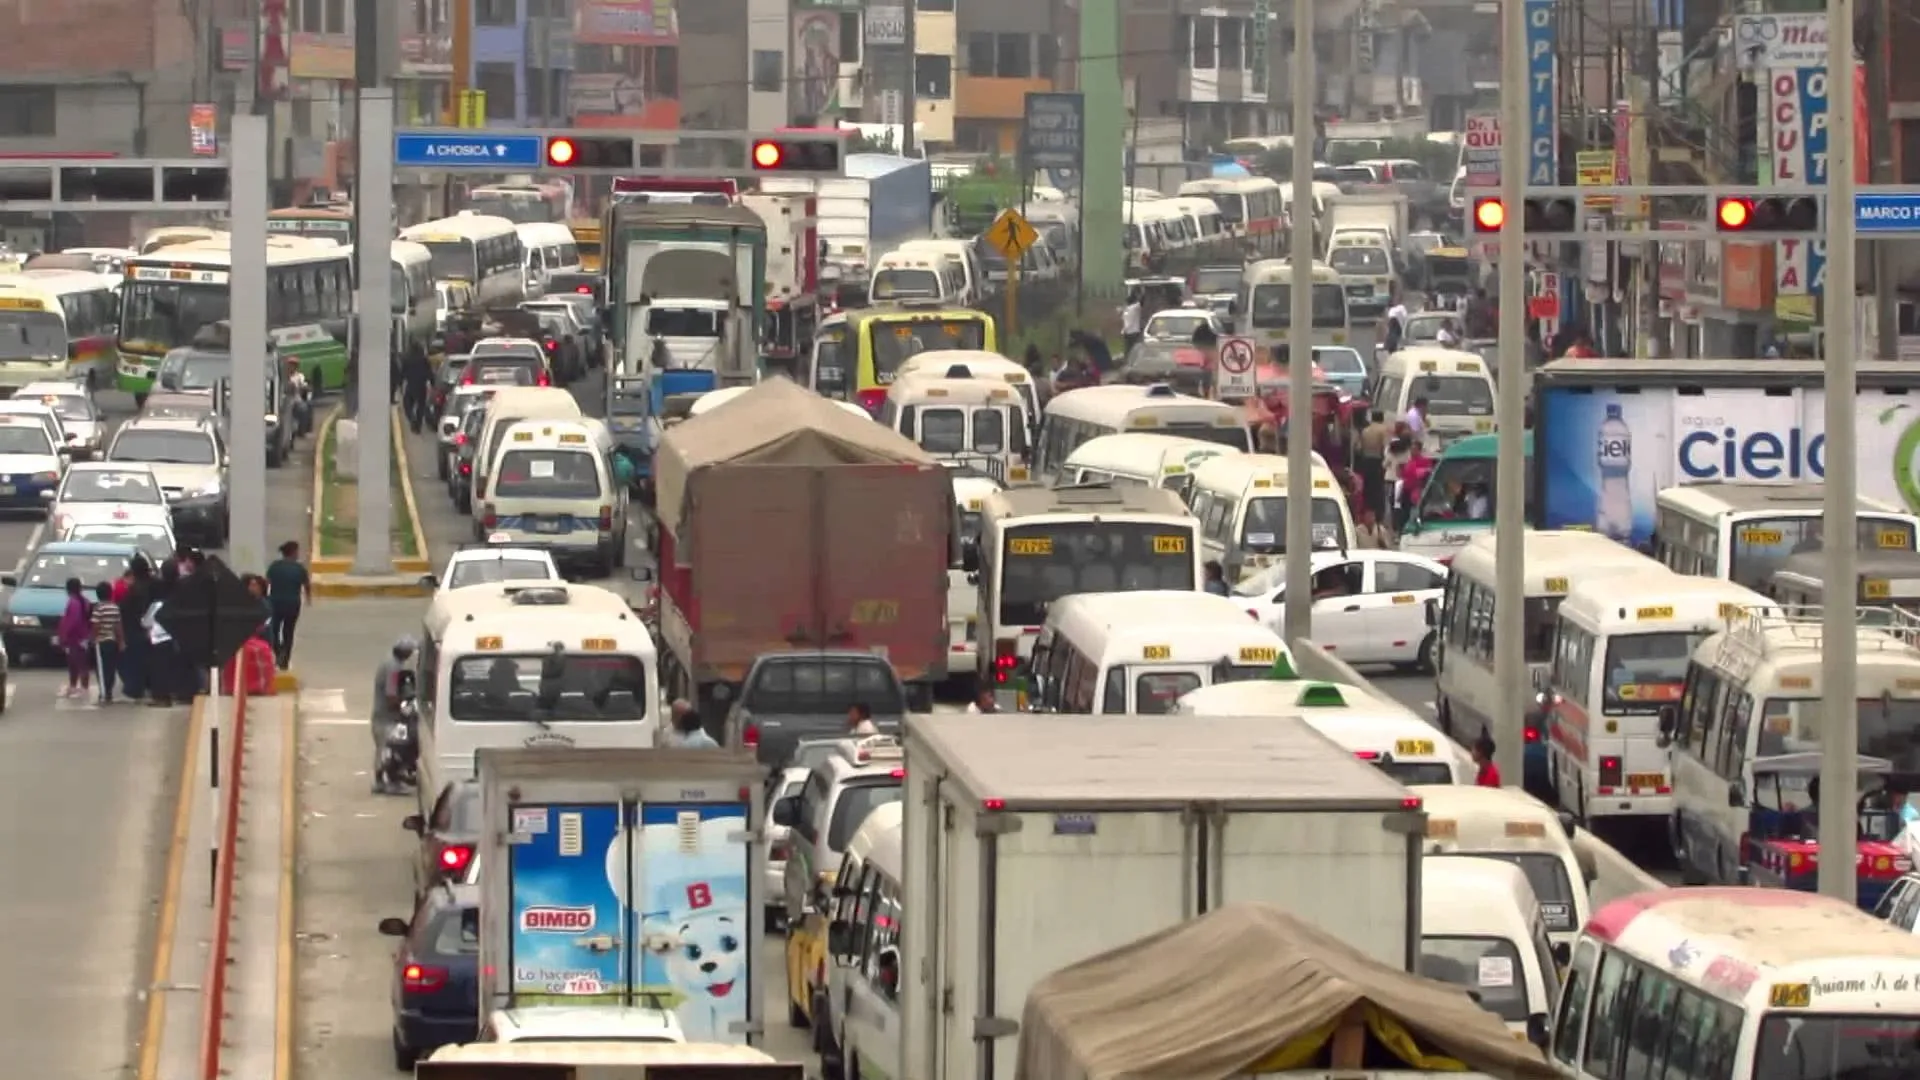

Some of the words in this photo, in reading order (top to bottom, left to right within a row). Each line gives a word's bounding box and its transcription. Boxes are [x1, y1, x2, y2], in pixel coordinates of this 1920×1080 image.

[1531, 8, 1551, 184] OPTICA
[1467, 132, 1502, 148] QUI
[426, 144, 436, 156] A
[437, 145, 491, 156] CHOSICA
[1774, 76, 1799, 287] OCULTA
[1860, 207, 1911, 219] MARCO
[526, 912, 591, 927] BIMBO
[518, 968, 535, 980] Lo
